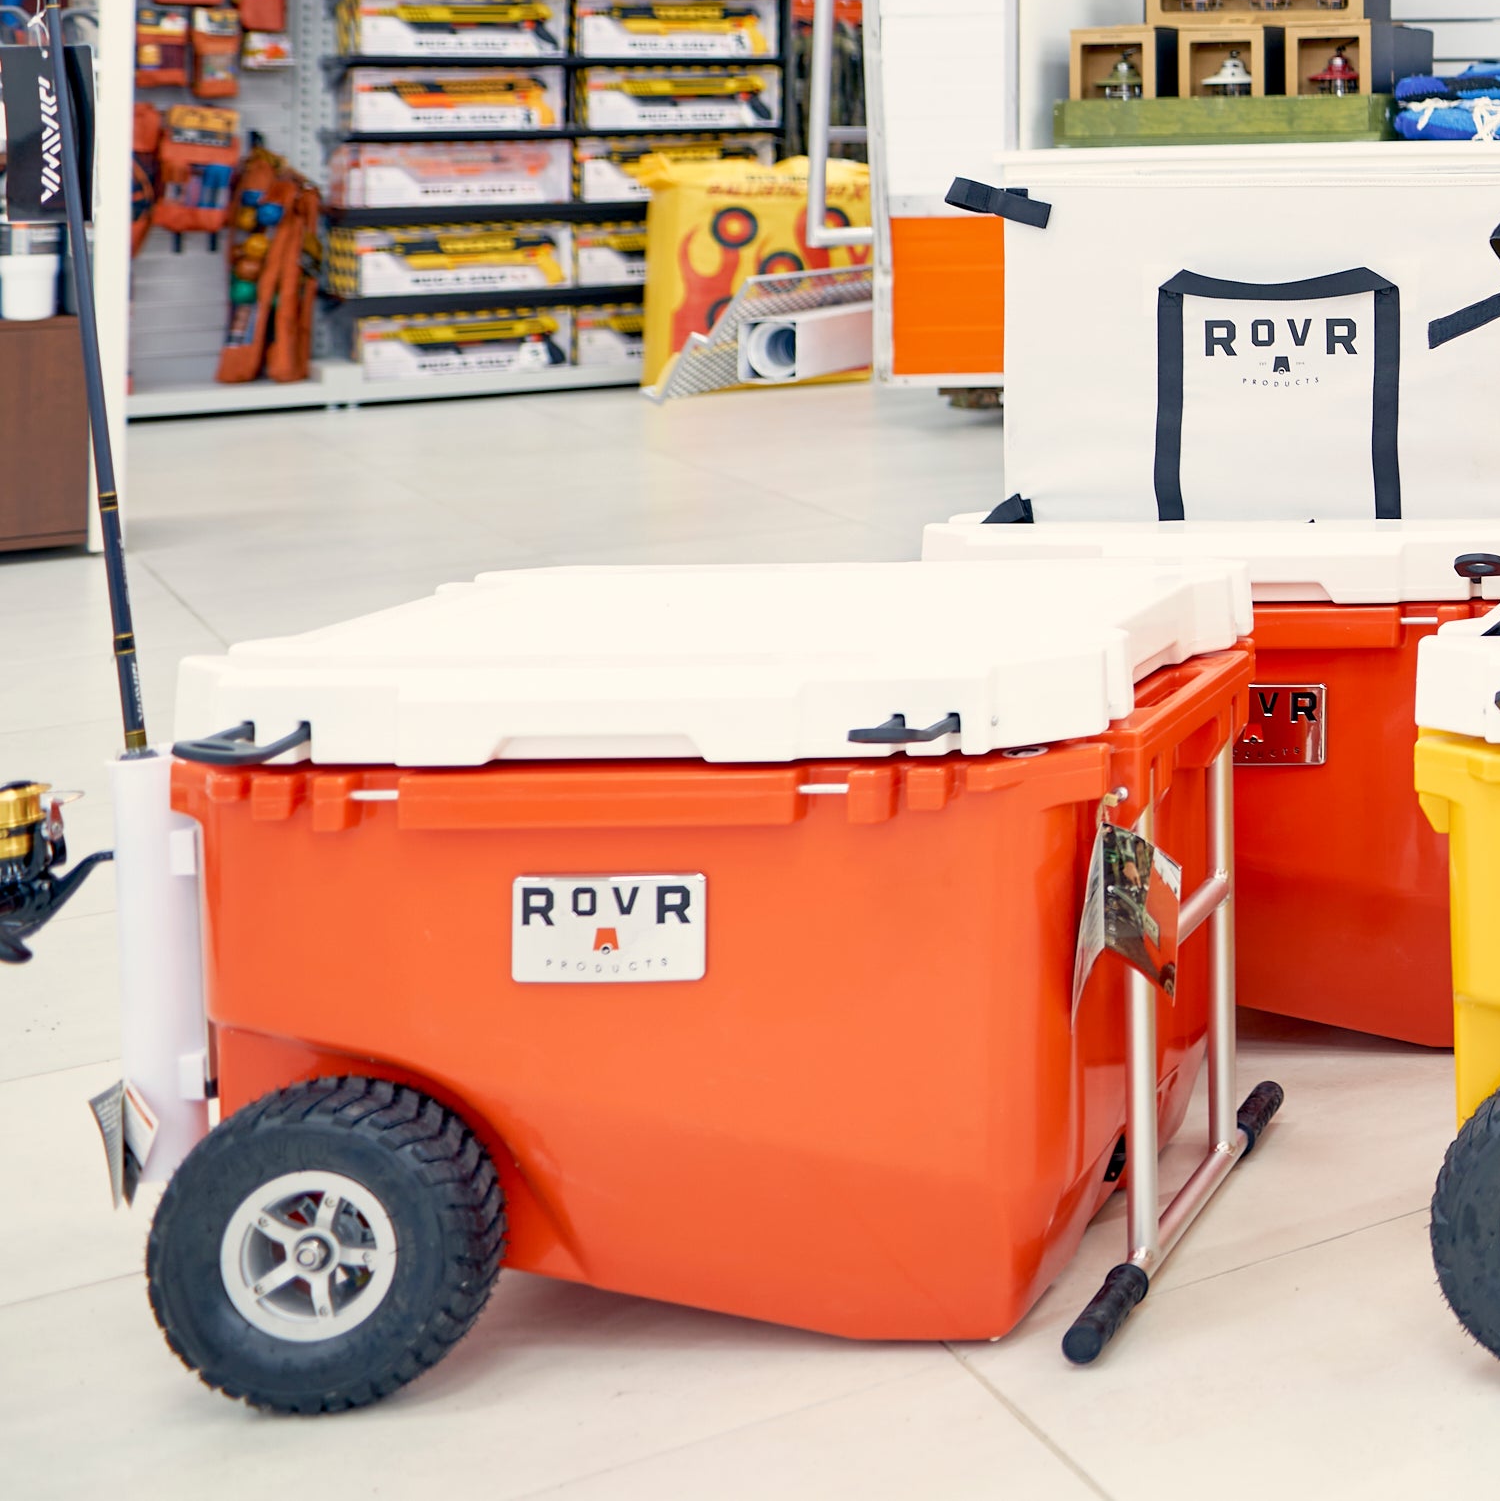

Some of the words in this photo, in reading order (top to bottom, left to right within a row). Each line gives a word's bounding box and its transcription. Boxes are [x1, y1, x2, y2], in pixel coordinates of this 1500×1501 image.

[38, 75, 62, 204] DAIWA
[1205, 317, 1359, 358] ROVR
[1242, 377, 1320, 389] PRODUCTS
[1258, 691, 1319, 723] VR
[522, 885, 692, 927] ROVR
[545, 956, 668, 974] PRODUCTS
